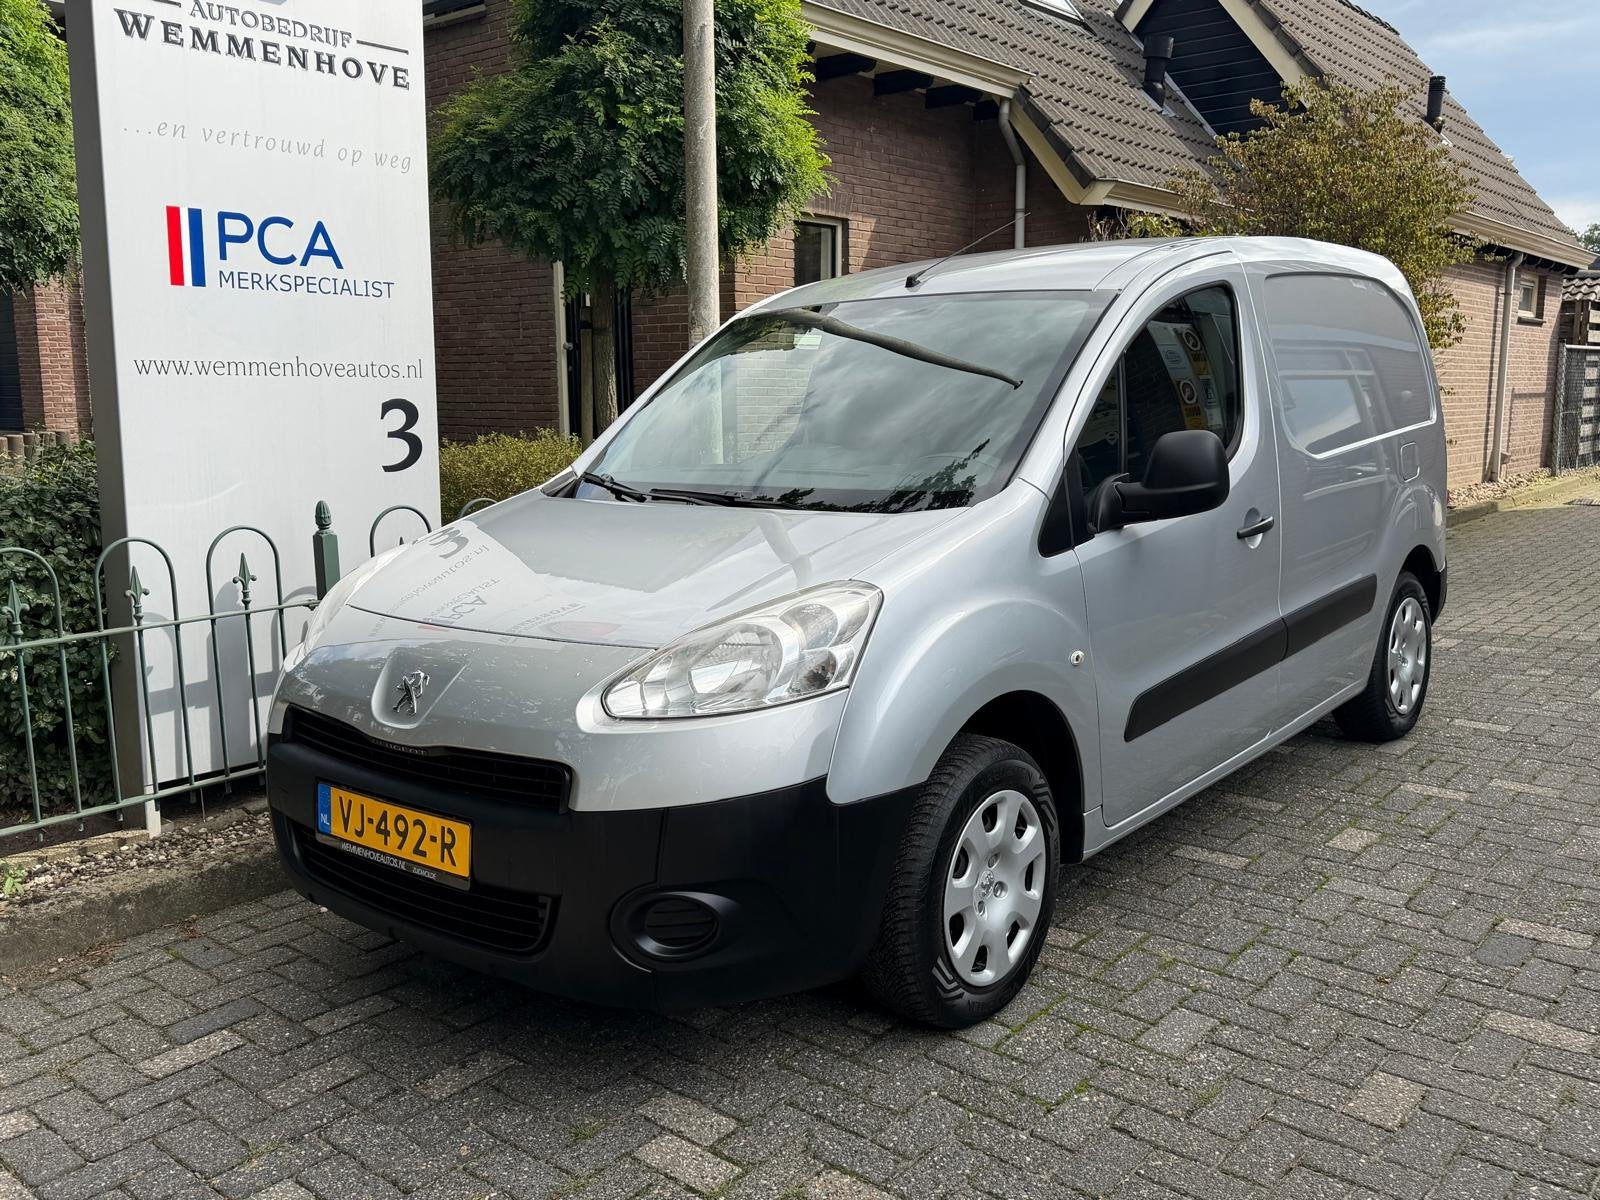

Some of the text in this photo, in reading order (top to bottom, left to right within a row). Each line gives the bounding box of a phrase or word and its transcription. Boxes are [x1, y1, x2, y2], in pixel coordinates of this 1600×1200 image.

[190, 0, 352, 48] AUTOBEDRIJF
[113, 8, 410, 90] WEMMENHOVE
[202, 127, 325, 158] vertrouwd
[337, 148, 362, 166] op
[374, 151, 412, 174] weg
[217, 211, 344, 269] PCA
[219, 270, 394, 299] MERKSPECIALIST
[133, 356, 423, 379] www.wemmenhoveautos.nl
[380, 397, 423, 473] 3
[320, 812, 330, 826] NL
[338, 795, 457, 867] VJ-492-R
